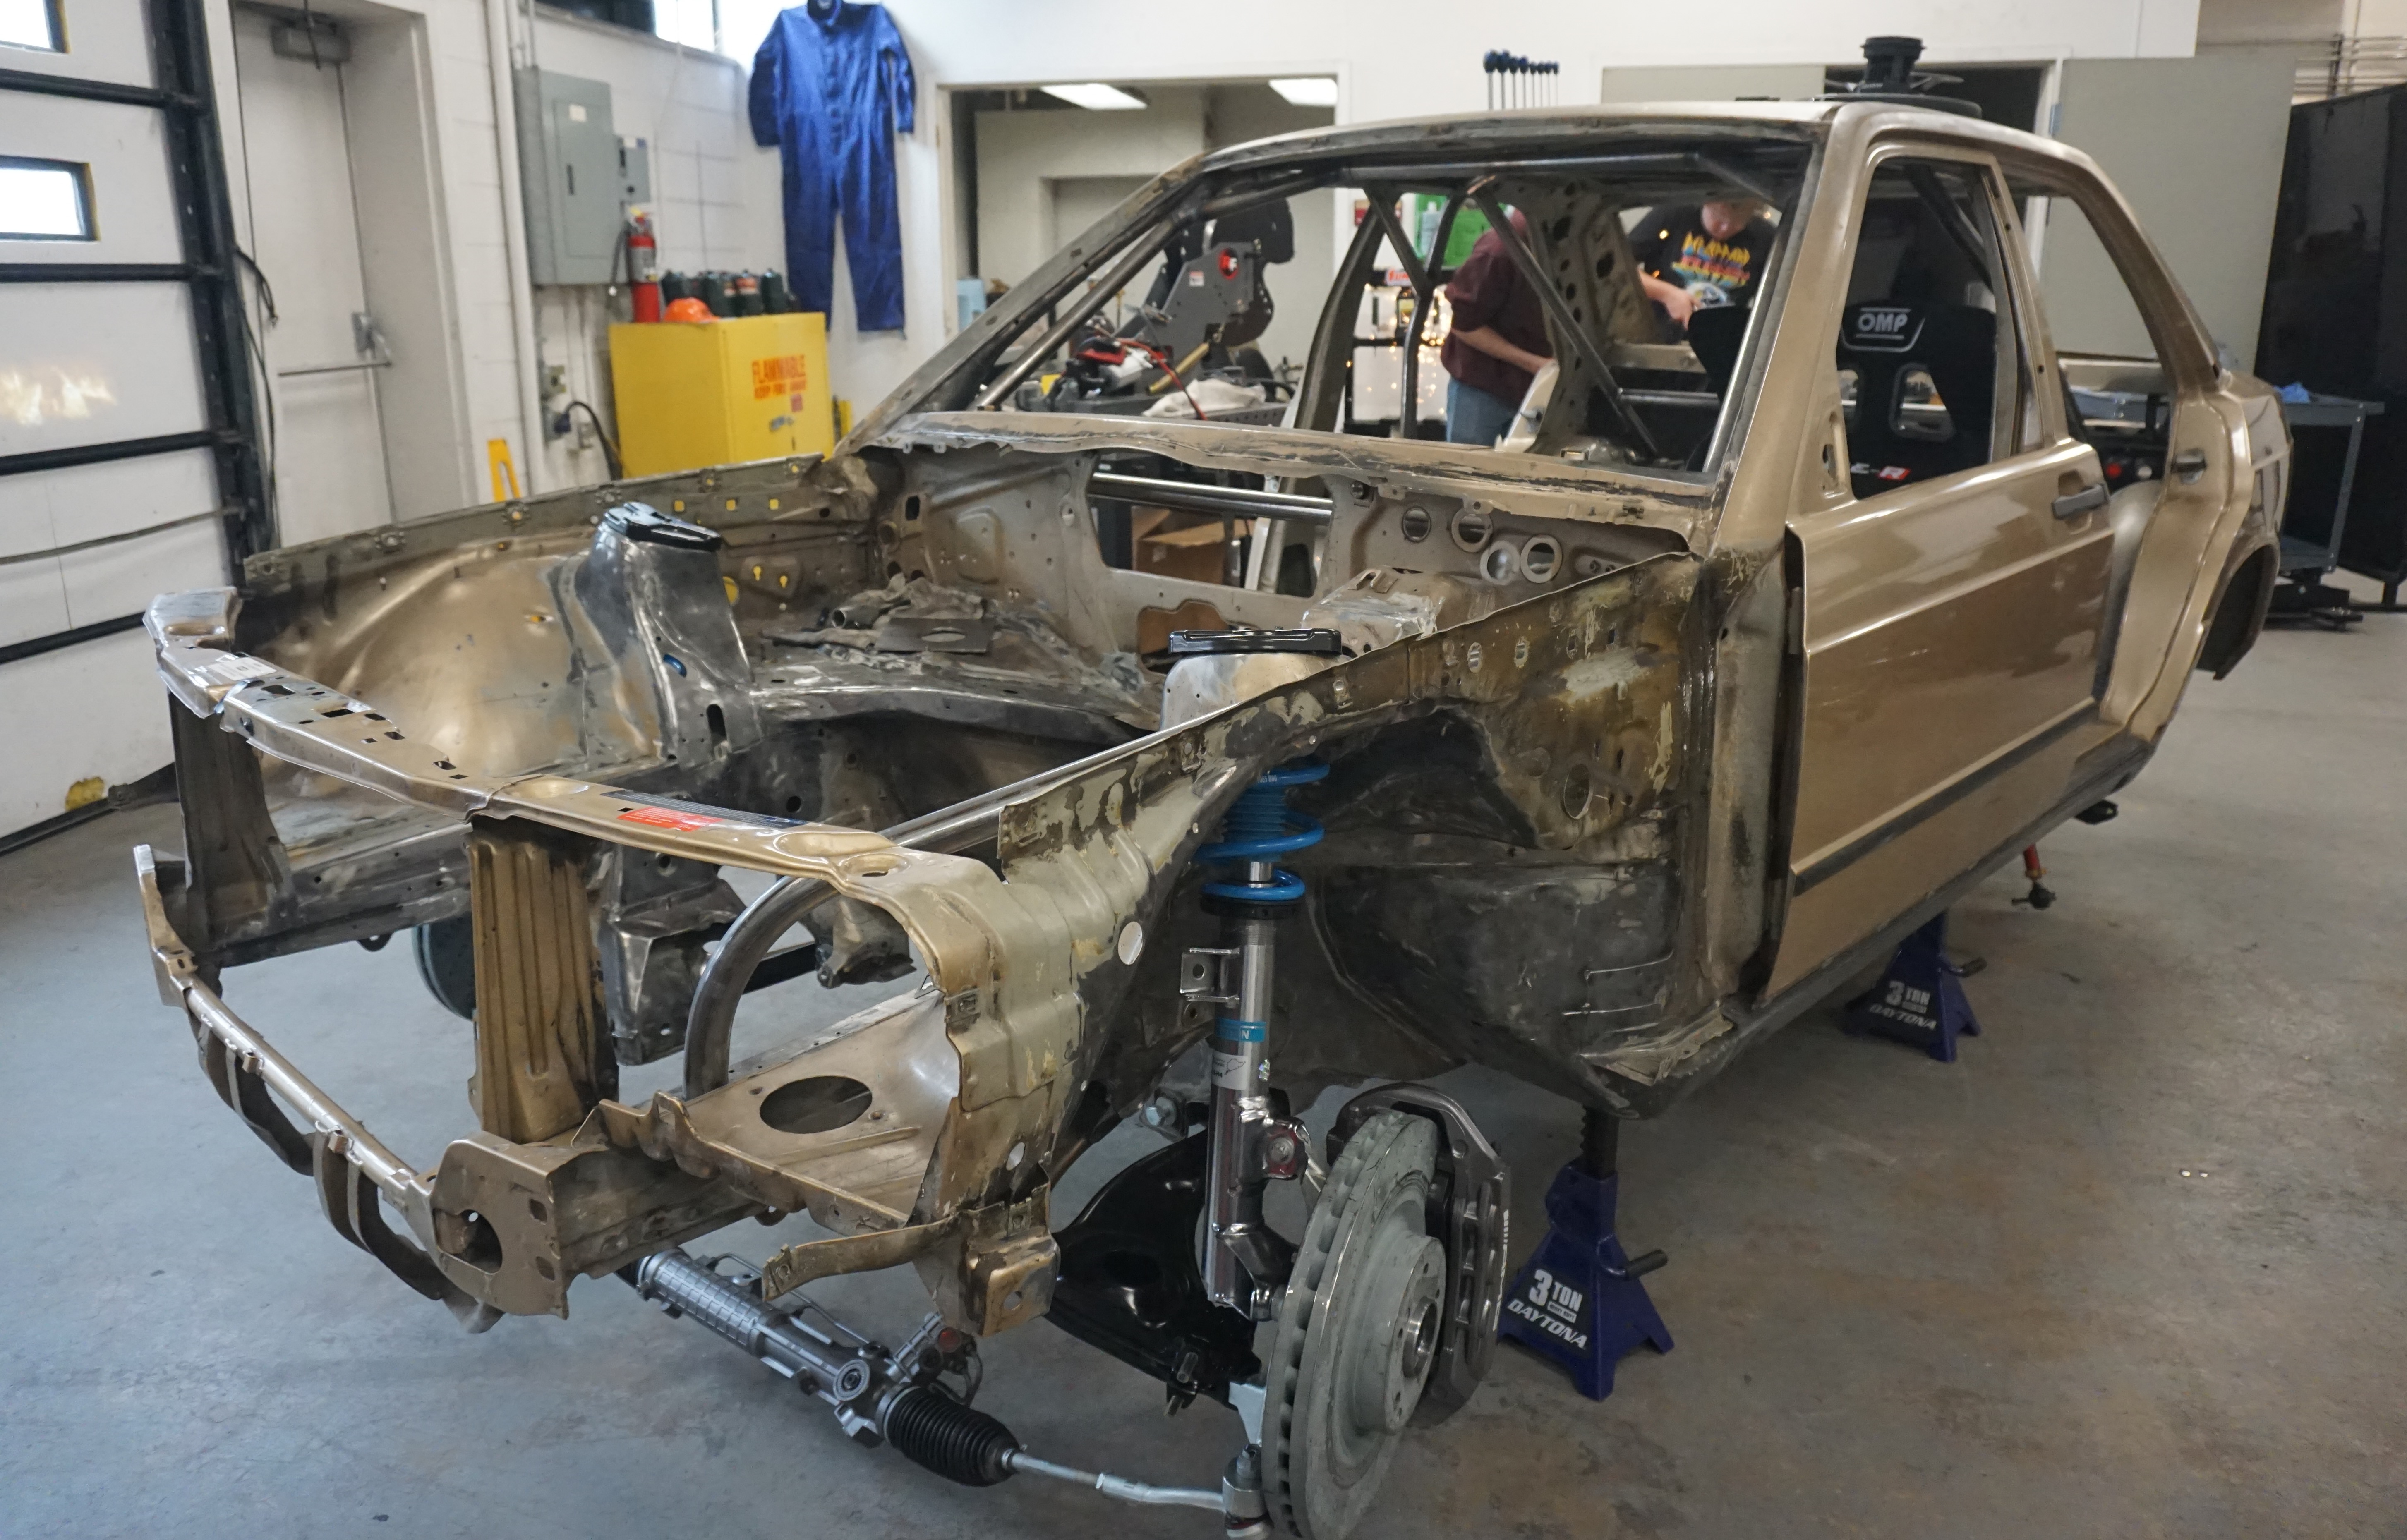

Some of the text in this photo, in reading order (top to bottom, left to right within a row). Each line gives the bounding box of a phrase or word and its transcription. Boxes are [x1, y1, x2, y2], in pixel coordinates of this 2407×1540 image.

[1858, 313, 1908, 332] OMP
[1886, 980, 1904, 1006] 3
[1529, 1268, 1583, 1312] 3 TON
[1507, 1299, 1588, 1349] DAYTONA
